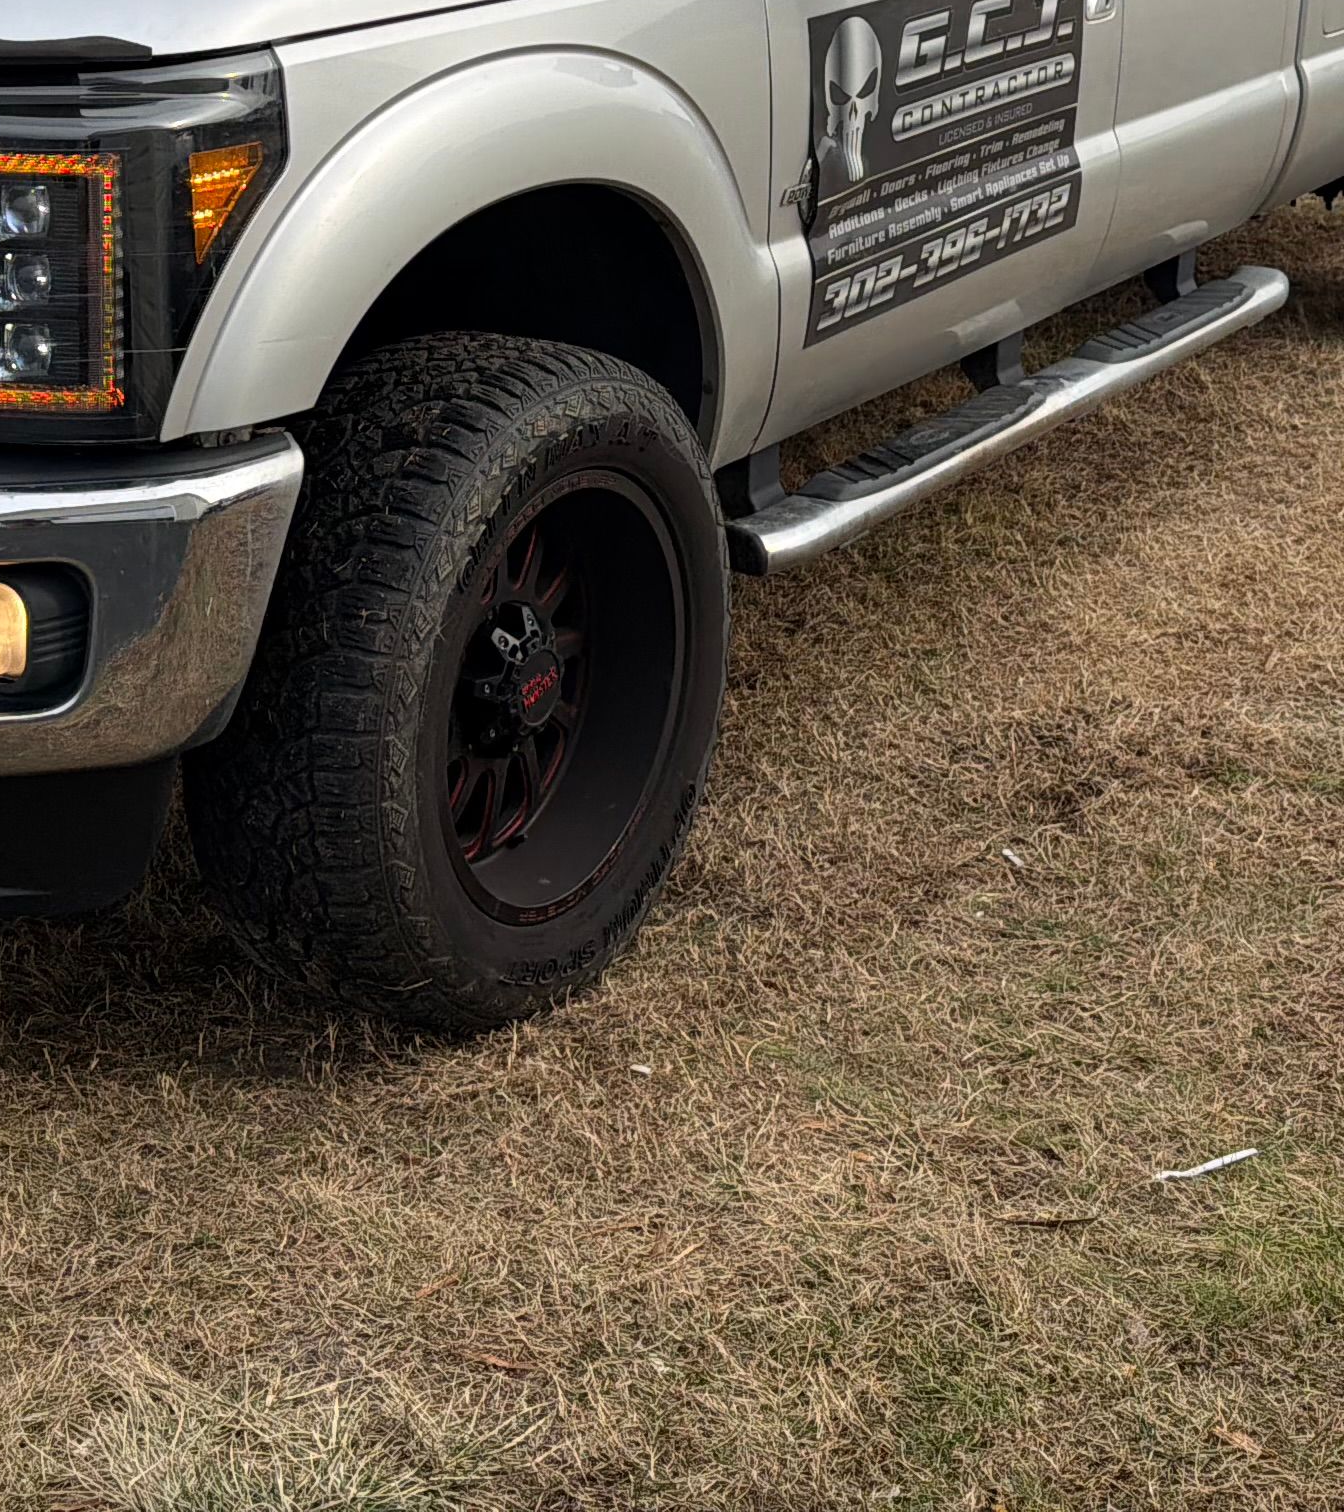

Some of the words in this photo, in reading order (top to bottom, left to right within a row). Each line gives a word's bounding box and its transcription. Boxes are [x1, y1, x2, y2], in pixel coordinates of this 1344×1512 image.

[902, 61, 1066, 131] CONTRACTOR
[939, 121, 984, 145] LICENSED
[995, 103, 1032, 125] INSURED
[829, 208, 885, 239] Additions
[895, 189, 928, 212] Decks
[981, 150, 1024, 177] Fixtures
[1026, 138, 1061, 160] Change
[880, 173, 916, 197] Doors
[925, 153, 970, 180] Flooring
[980, 137, 1004, 157] Trim
[1011, 118, 1066, 146] Remodeling
[827, 230, 885, 265] Furniture
[888, 205, 942, 236] Assembly
[950, 190, 984, 212] Smart
[985, 168, 1038, 196] Appliances
[1039, 159, 1057, 175] Set
[1058, 153, 1070, 169] Up
[816, 183, 1071, 331] 302-396-1732
[500, 939, 596, 985] SPORT
